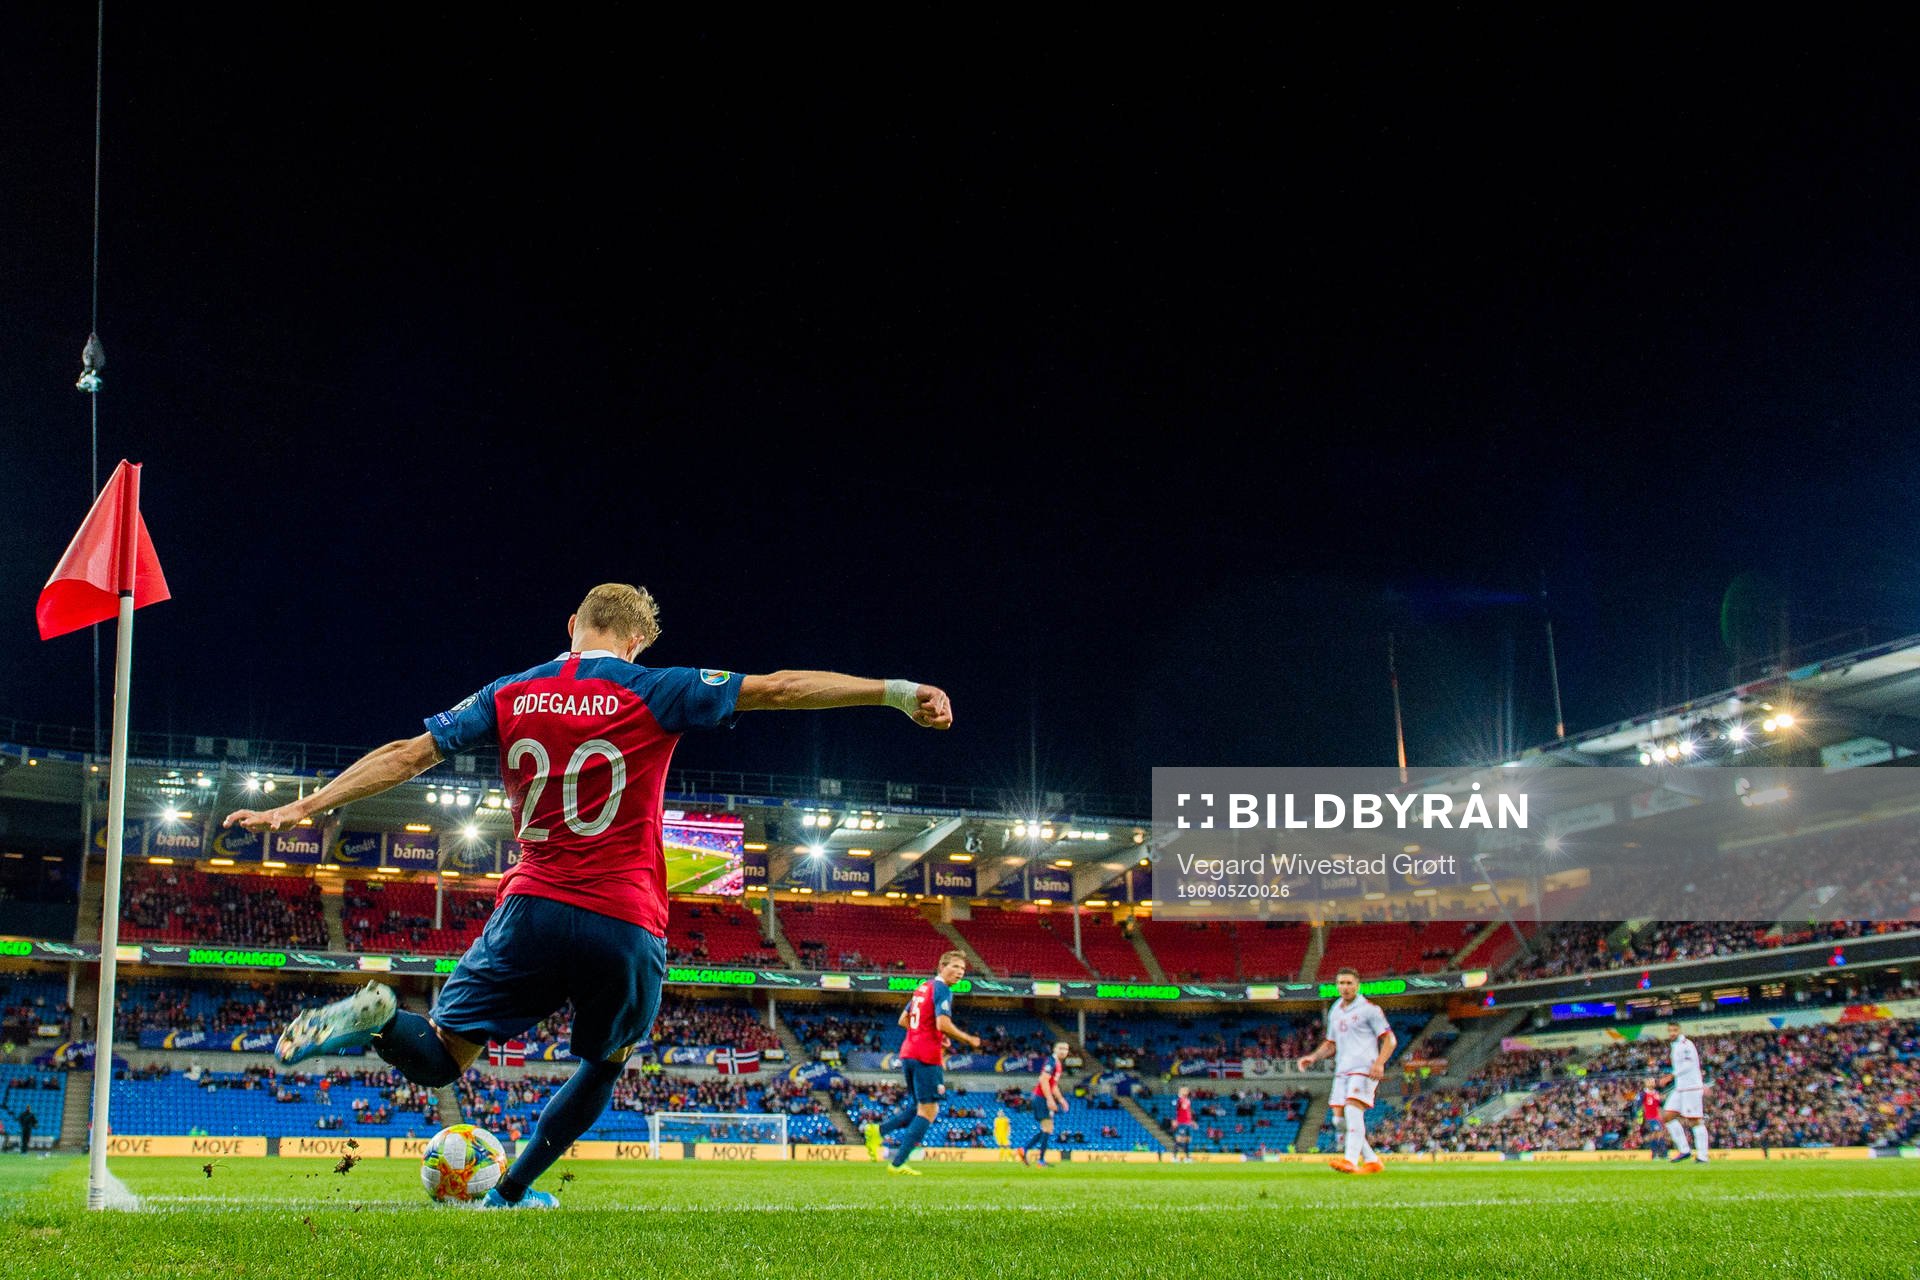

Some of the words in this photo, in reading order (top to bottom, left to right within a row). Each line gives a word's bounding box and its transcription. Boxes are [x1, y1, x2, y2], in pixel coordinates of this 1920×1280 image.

[513, 693, 619, 717] ØDEGAARD
[508, 738, 627, 842] 20
[156, 831, 199, 848] bama
[276, 837, 319, 854] bama
[393, 843, 434, 860] bama
[508, 850, 523, 865] ba
[744, 865, 766, 877] ma
[833, 867, 870, 882] bama
[935, 872, 972, 888] bama
[1034, 877, 1070, 893] bama
[188, 950, 225, 965] 100%
[224, 951, 287, 967] CHARGED
[668, 968, 701, 983] 100%
[701, 969, 757, 985] CHARGED
[191, 1139, 243, 1154] MOVE
[299, 1140, 347, 1155] MOVE
[712, 1146, 757, 1160] MOVE
[806, 1147, 850, 1161] MOVE
